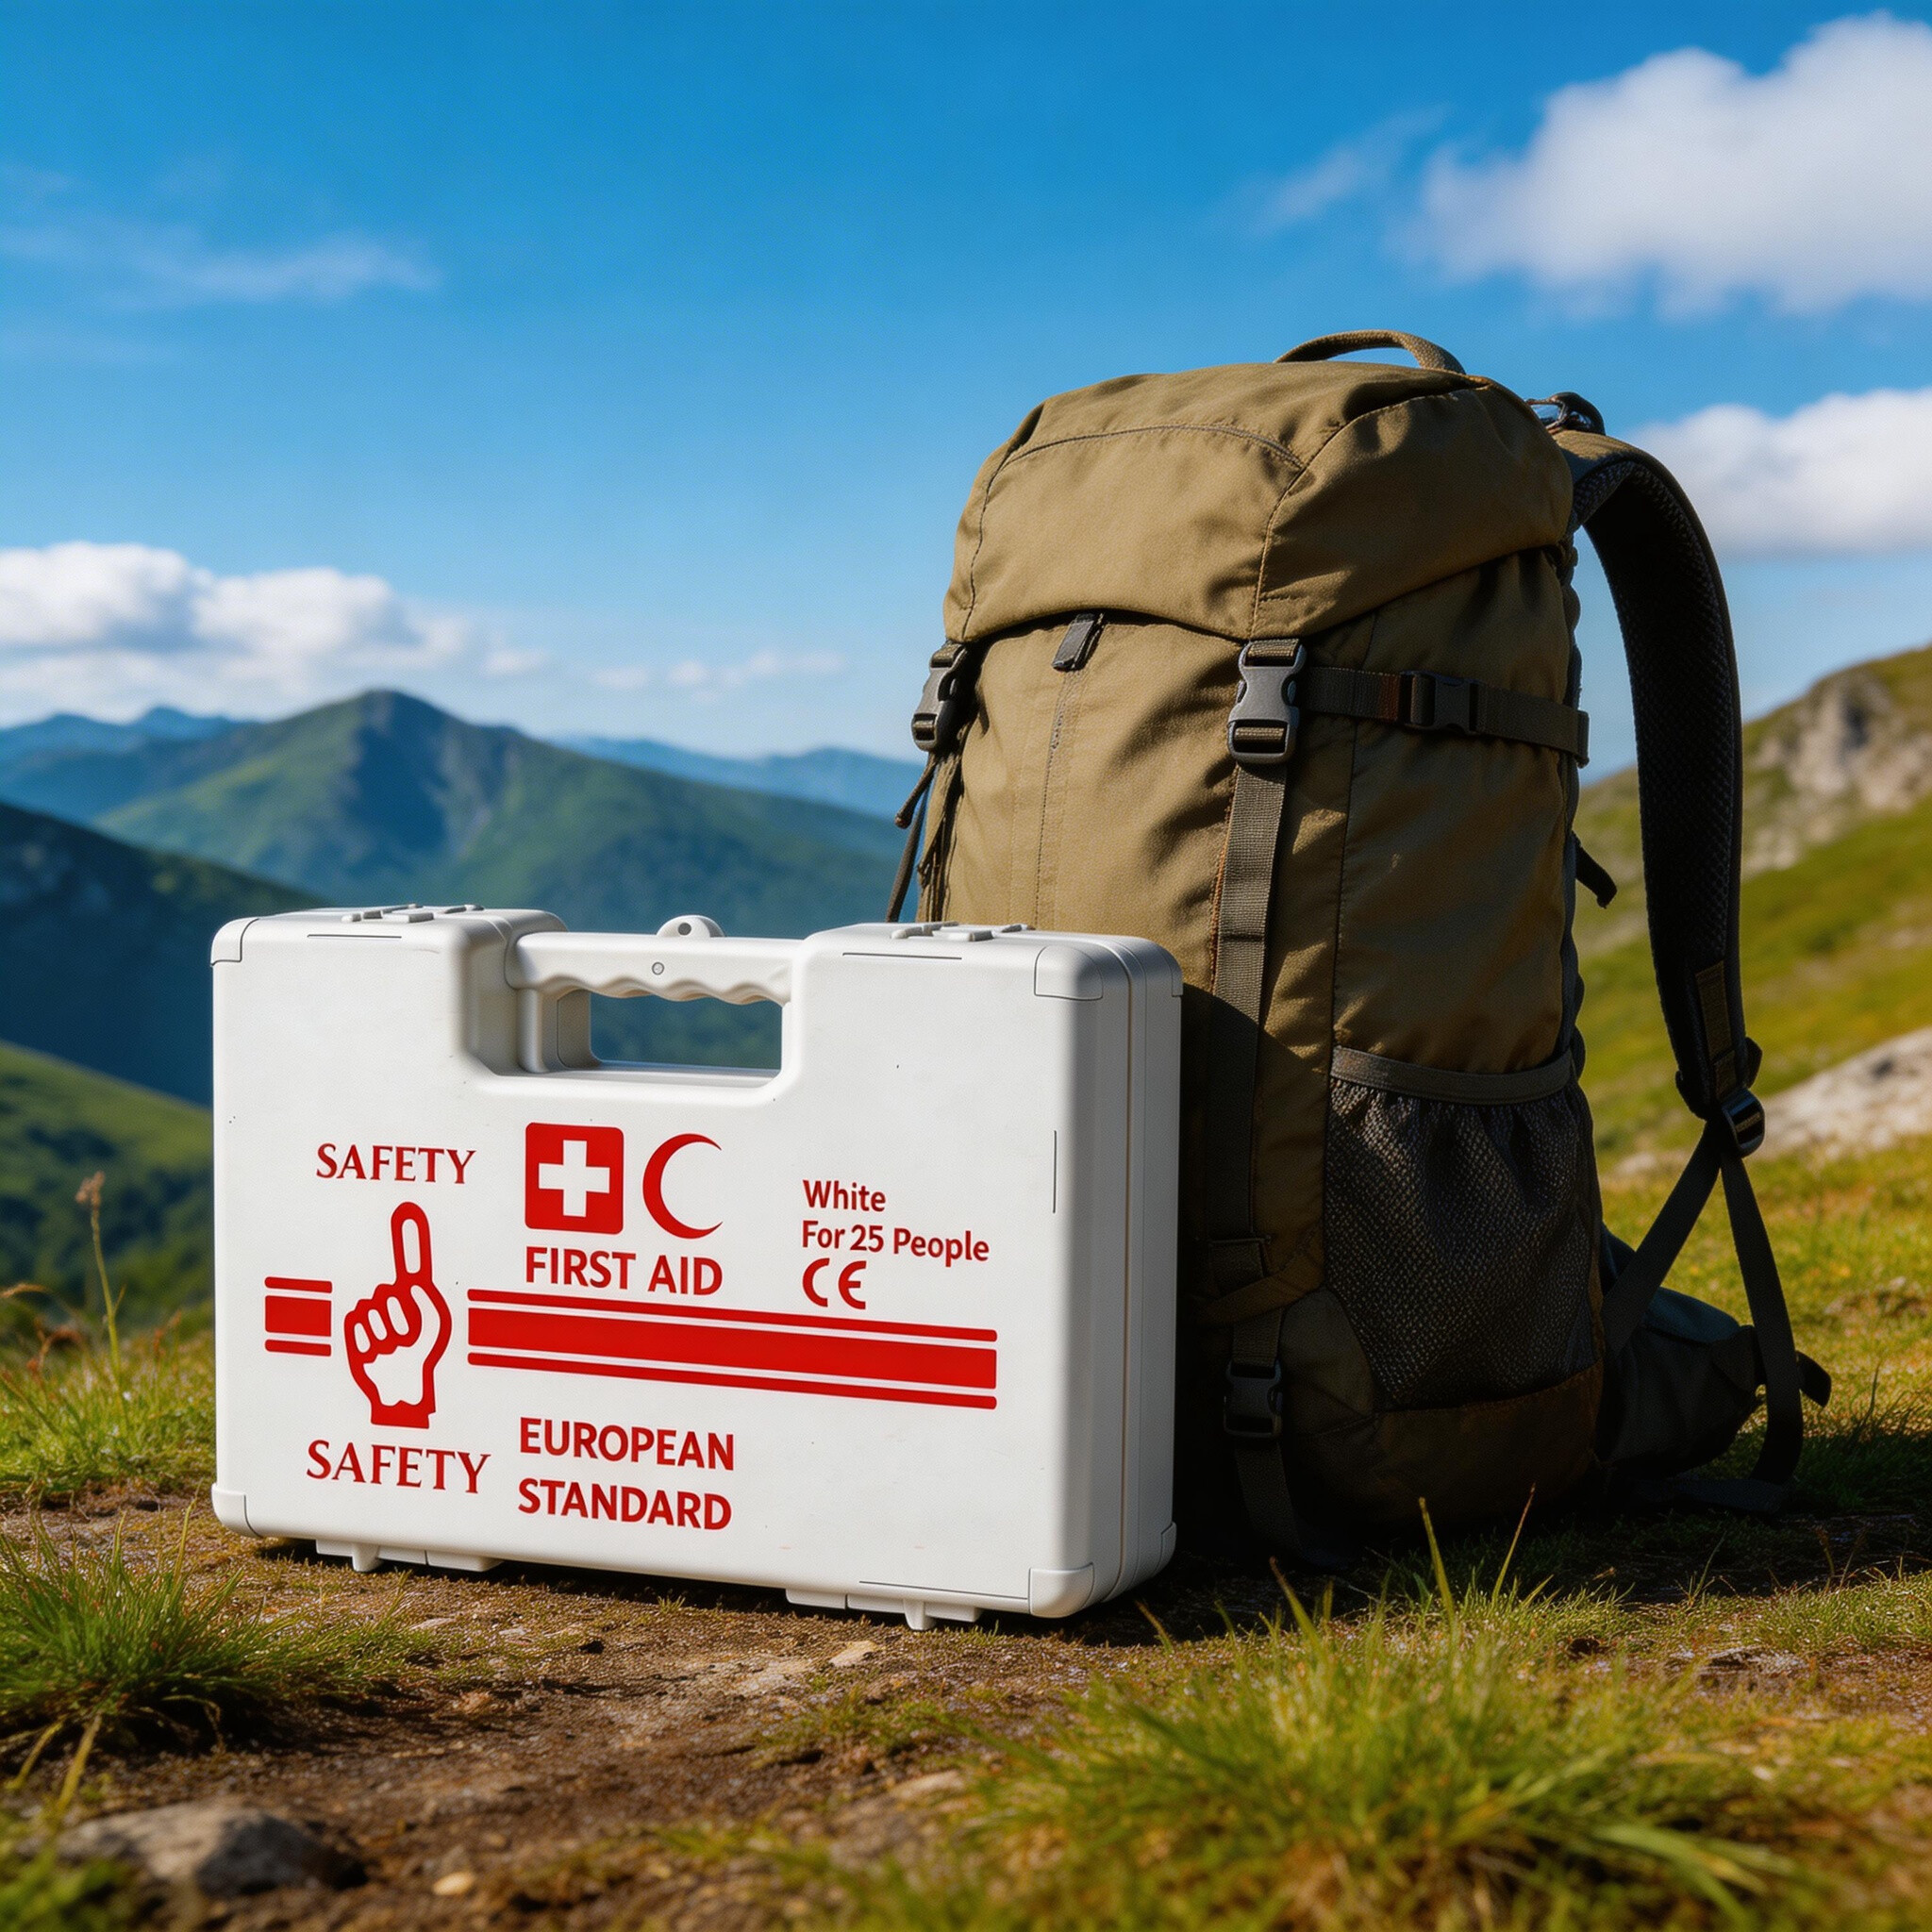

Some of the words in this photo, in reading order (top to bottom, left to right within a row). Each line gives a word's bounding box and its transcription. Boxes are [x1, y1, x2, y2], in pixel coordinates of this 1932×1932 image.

[316, 1142, 475, 1185] SAFETY
[802, 1178, 886, 1212] White
[802, 1219, 846, 1249] For
[849, 1224, 884, 1254] 25
[892, 1227, 990, 1269] People
[525, 1245, 637, 1291] FIRST
[647, 1254, 724, 1297] AID
[801, 1257, 868, 1310] CE
[307, 1439, 490, 1495] SAFETY
[519, 1416, 735, 1472] EUROPEAN
[518, 1476, 733, 1531] STANDARD
